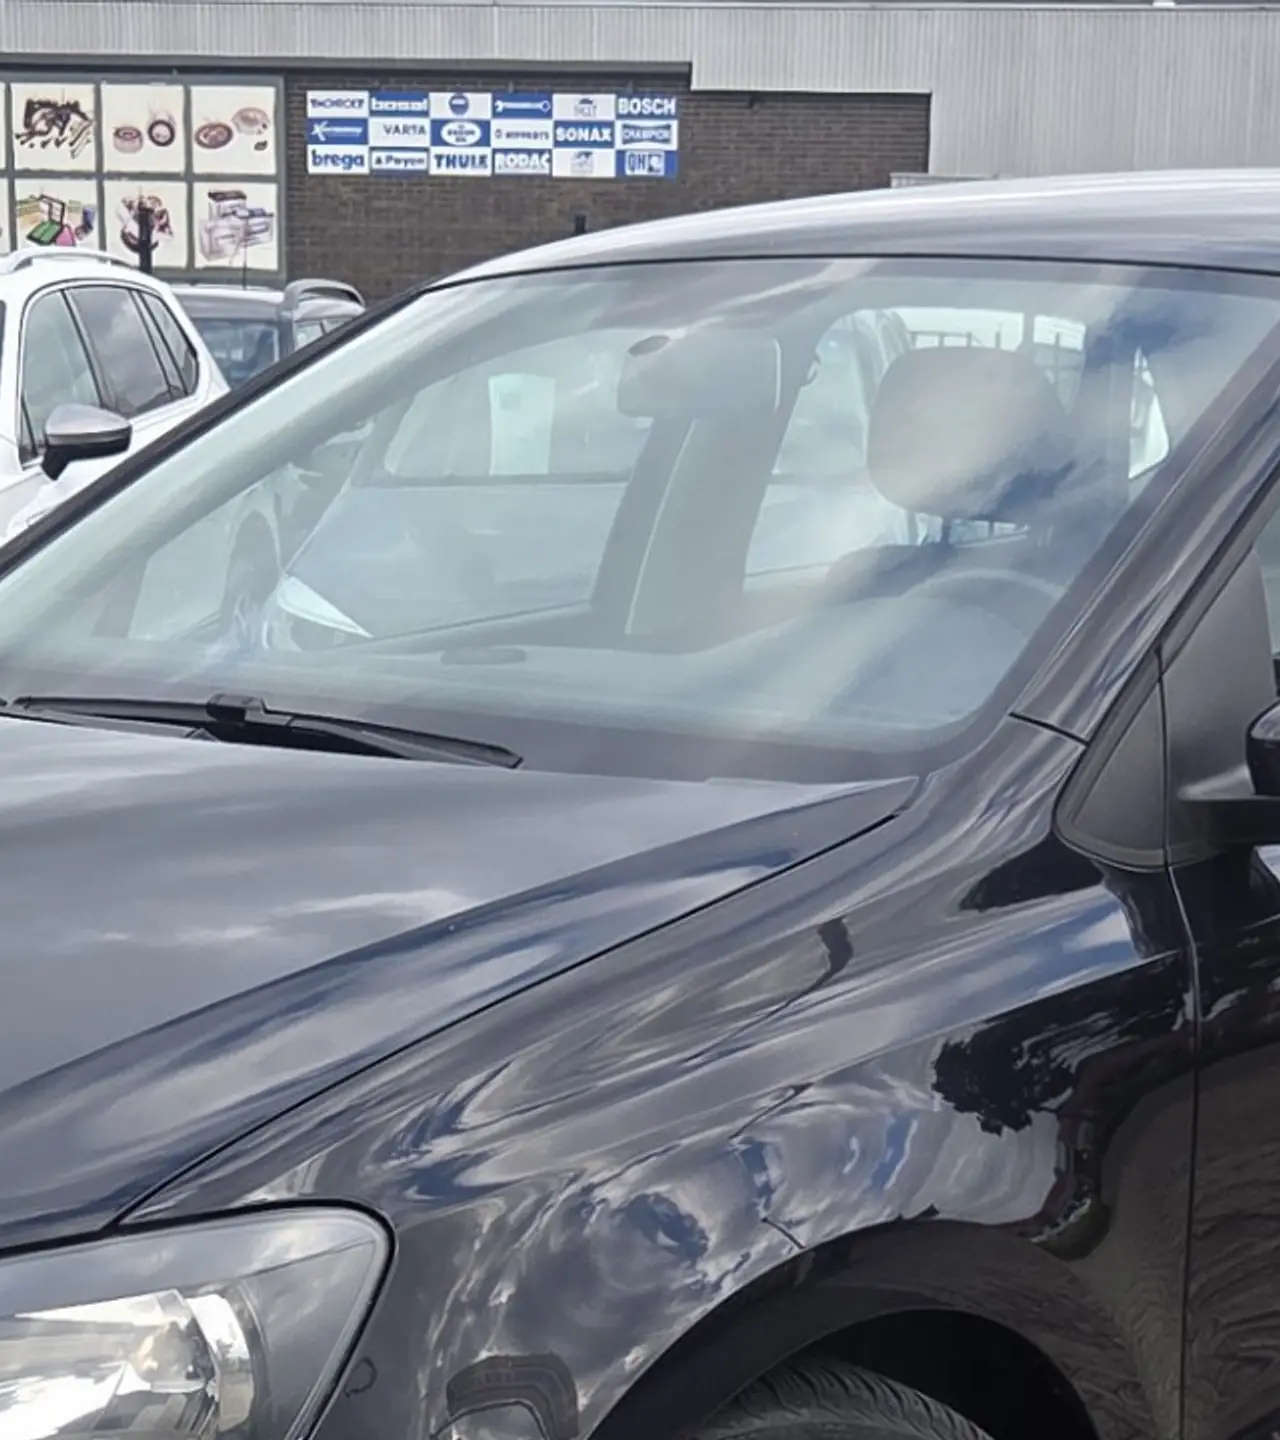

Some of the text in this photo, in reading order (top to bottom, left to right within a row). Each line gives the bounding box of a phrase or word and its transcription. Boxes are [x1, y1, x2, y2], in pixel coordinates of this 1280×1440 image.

[618, 97, 677, 115] BOSCH
[383, 123, 427, 136] VARTA
[555, 126, 612, 142] SONAX
[312, 150, 365, 171] brega
